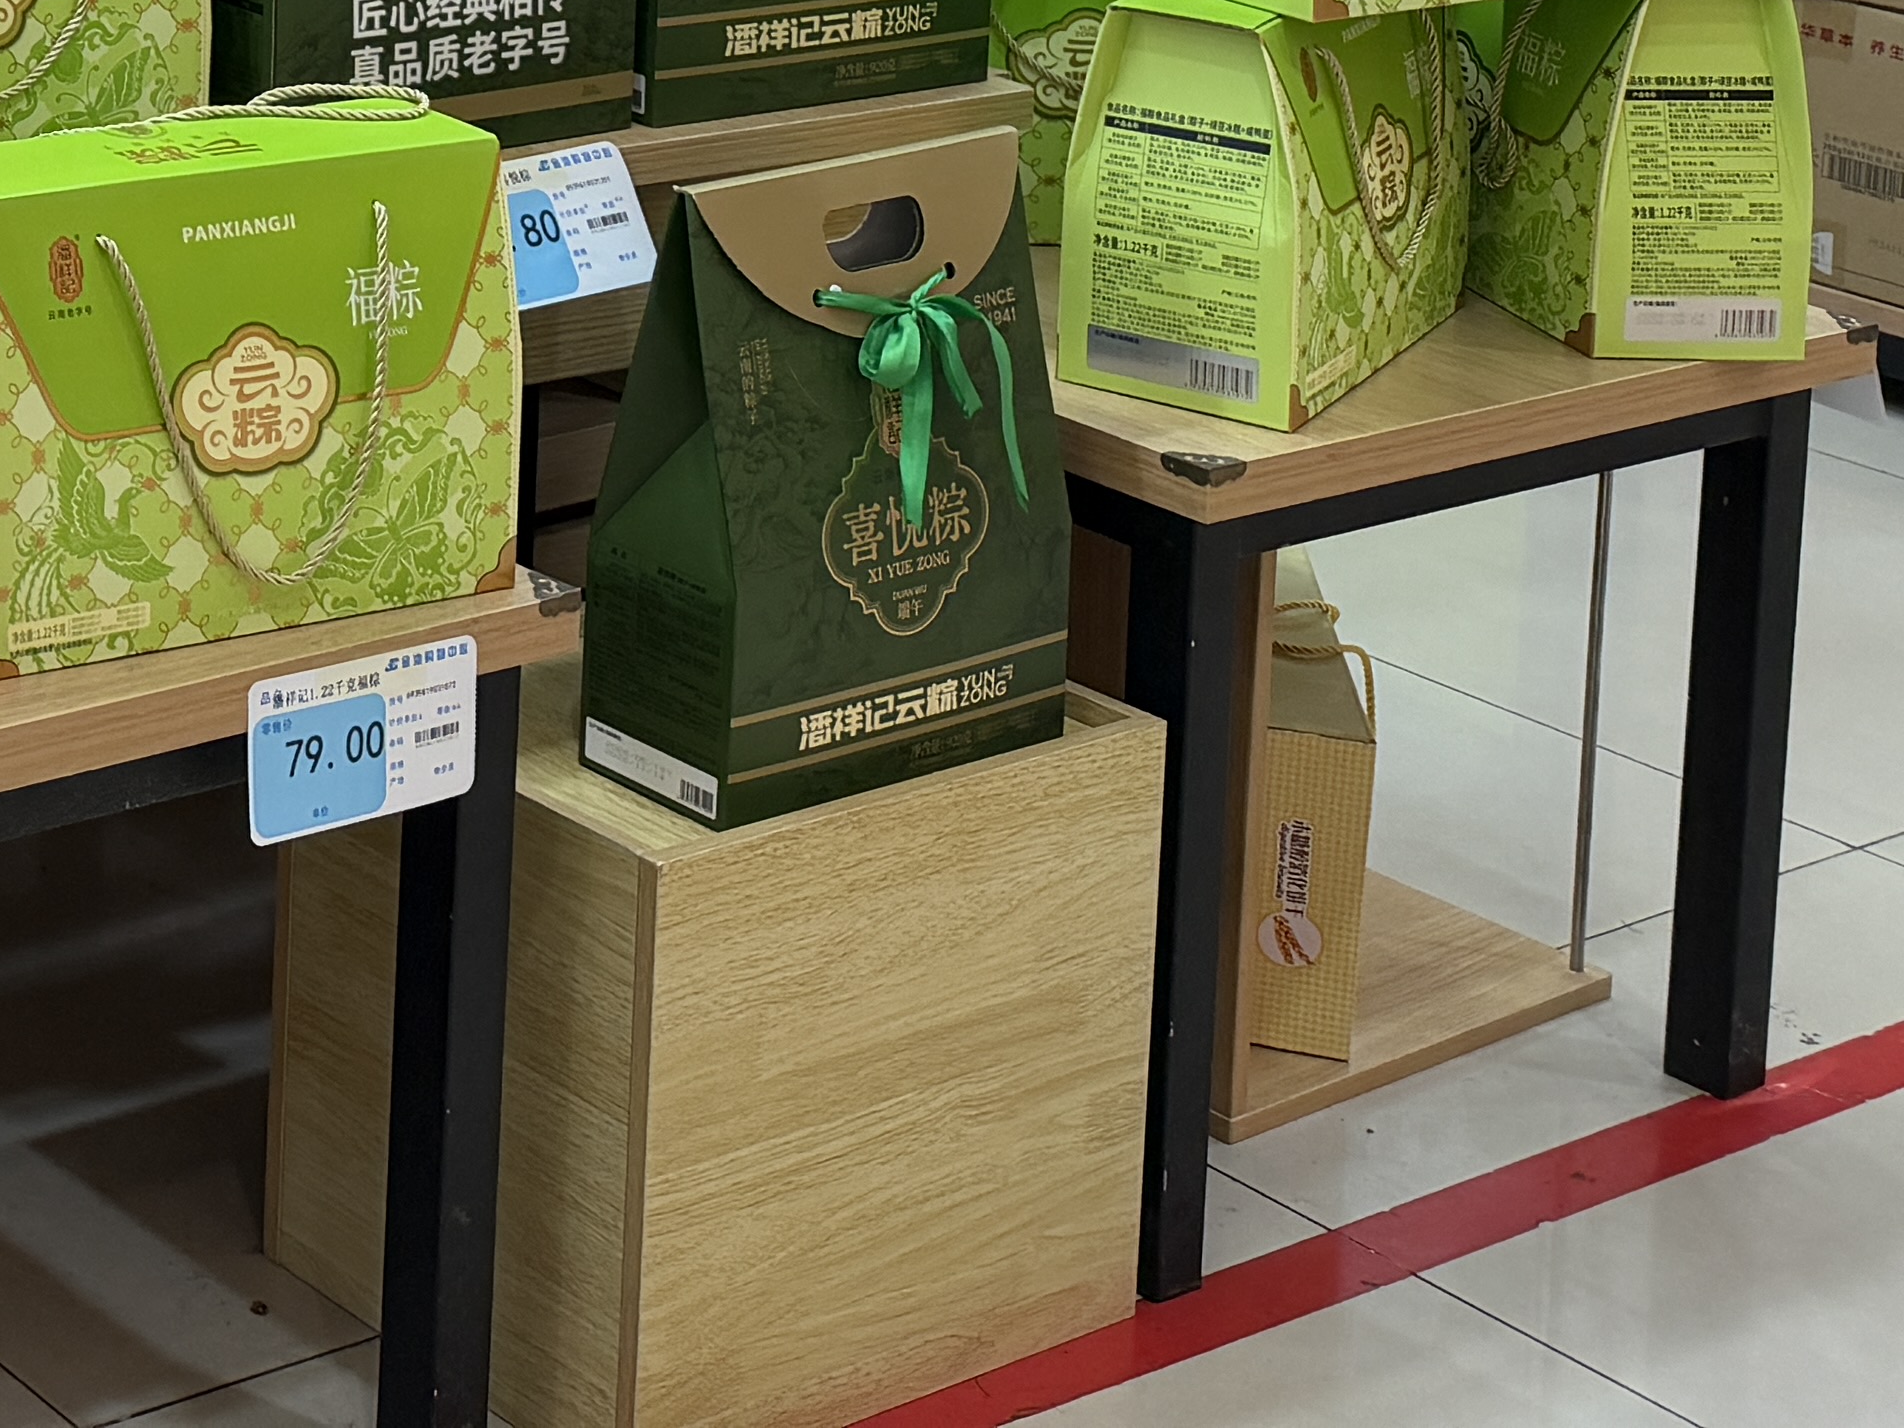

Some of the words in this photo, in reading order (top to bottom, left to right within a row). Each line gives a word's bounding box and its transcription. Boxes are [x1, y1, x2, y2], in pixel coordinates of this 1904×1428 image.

[350, 22, 571, 87] 真品质老字号
[724, 8, 883, 57] 潘祥记云粽
[181, 213, 296, 244] PANXIANGJI
[344, 260, 423, 328] 福粽
[973, 287, 1015, 310] SINCE
[228, 364, 283, 447] 云粽
[842, 484, 971, 564] 喜悦粽
[868, 567, 883, 584] XI
[886, 560, 913, 579] YUE
[916, 550, 950, 570] ZONG
[799, 679, 958, 750] 潘祥记云粽
[285, 720, 385, 778] 79.00
